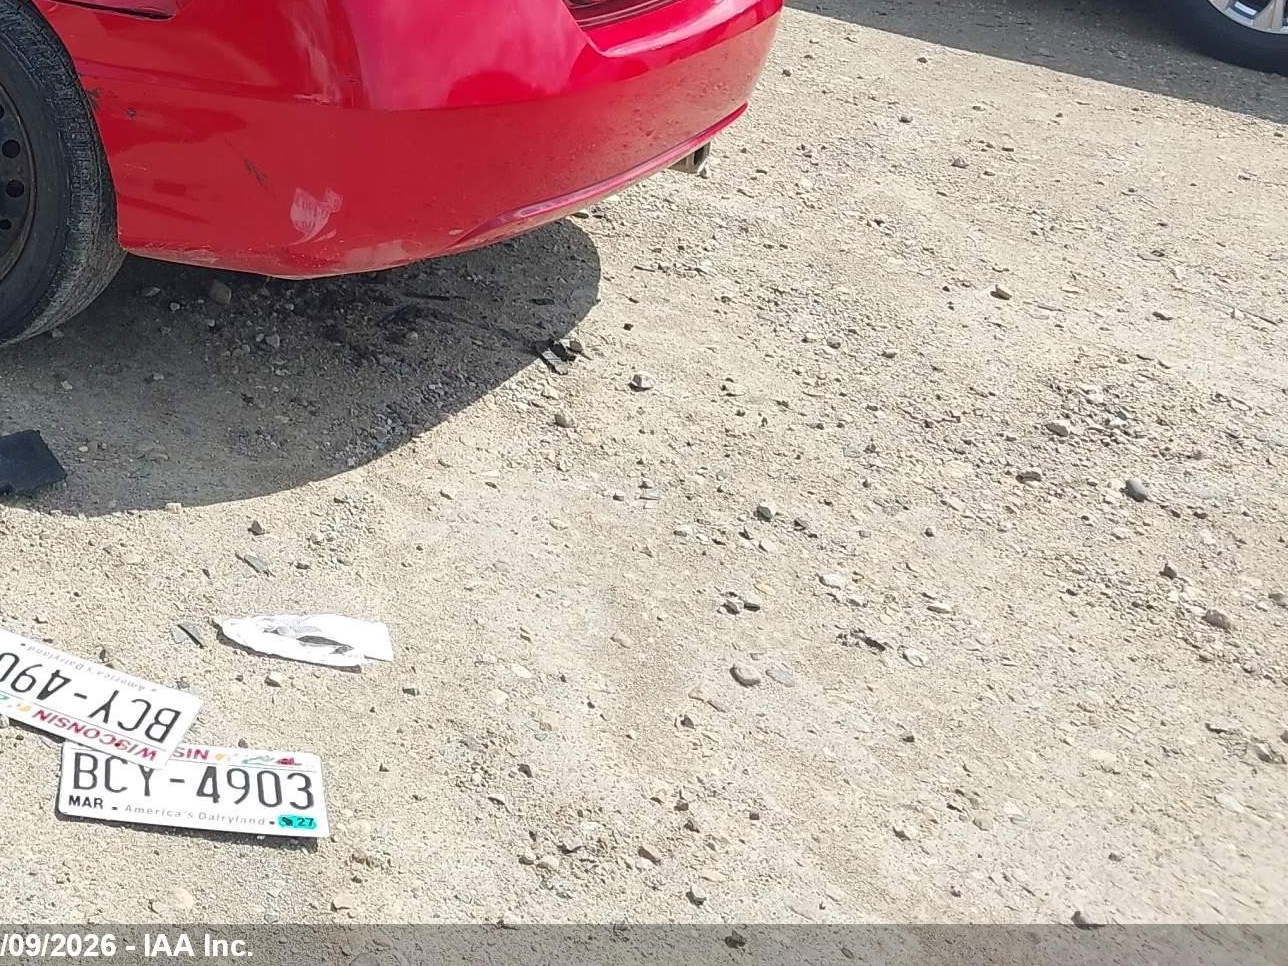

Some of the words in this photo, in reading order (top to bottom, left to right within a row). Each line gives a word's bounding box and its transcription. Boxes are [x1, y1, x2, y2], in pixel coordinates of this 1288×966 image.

[32, 709, 158, 761] WISCONSIN
[72, 751, 315, 811] BCY-4903
[68, 794, 105, 810] MAR
[124, 803, 194, 819] America's
[198, 811, 266, 827] Dairyland
[297, 817, 314, 827] 27
